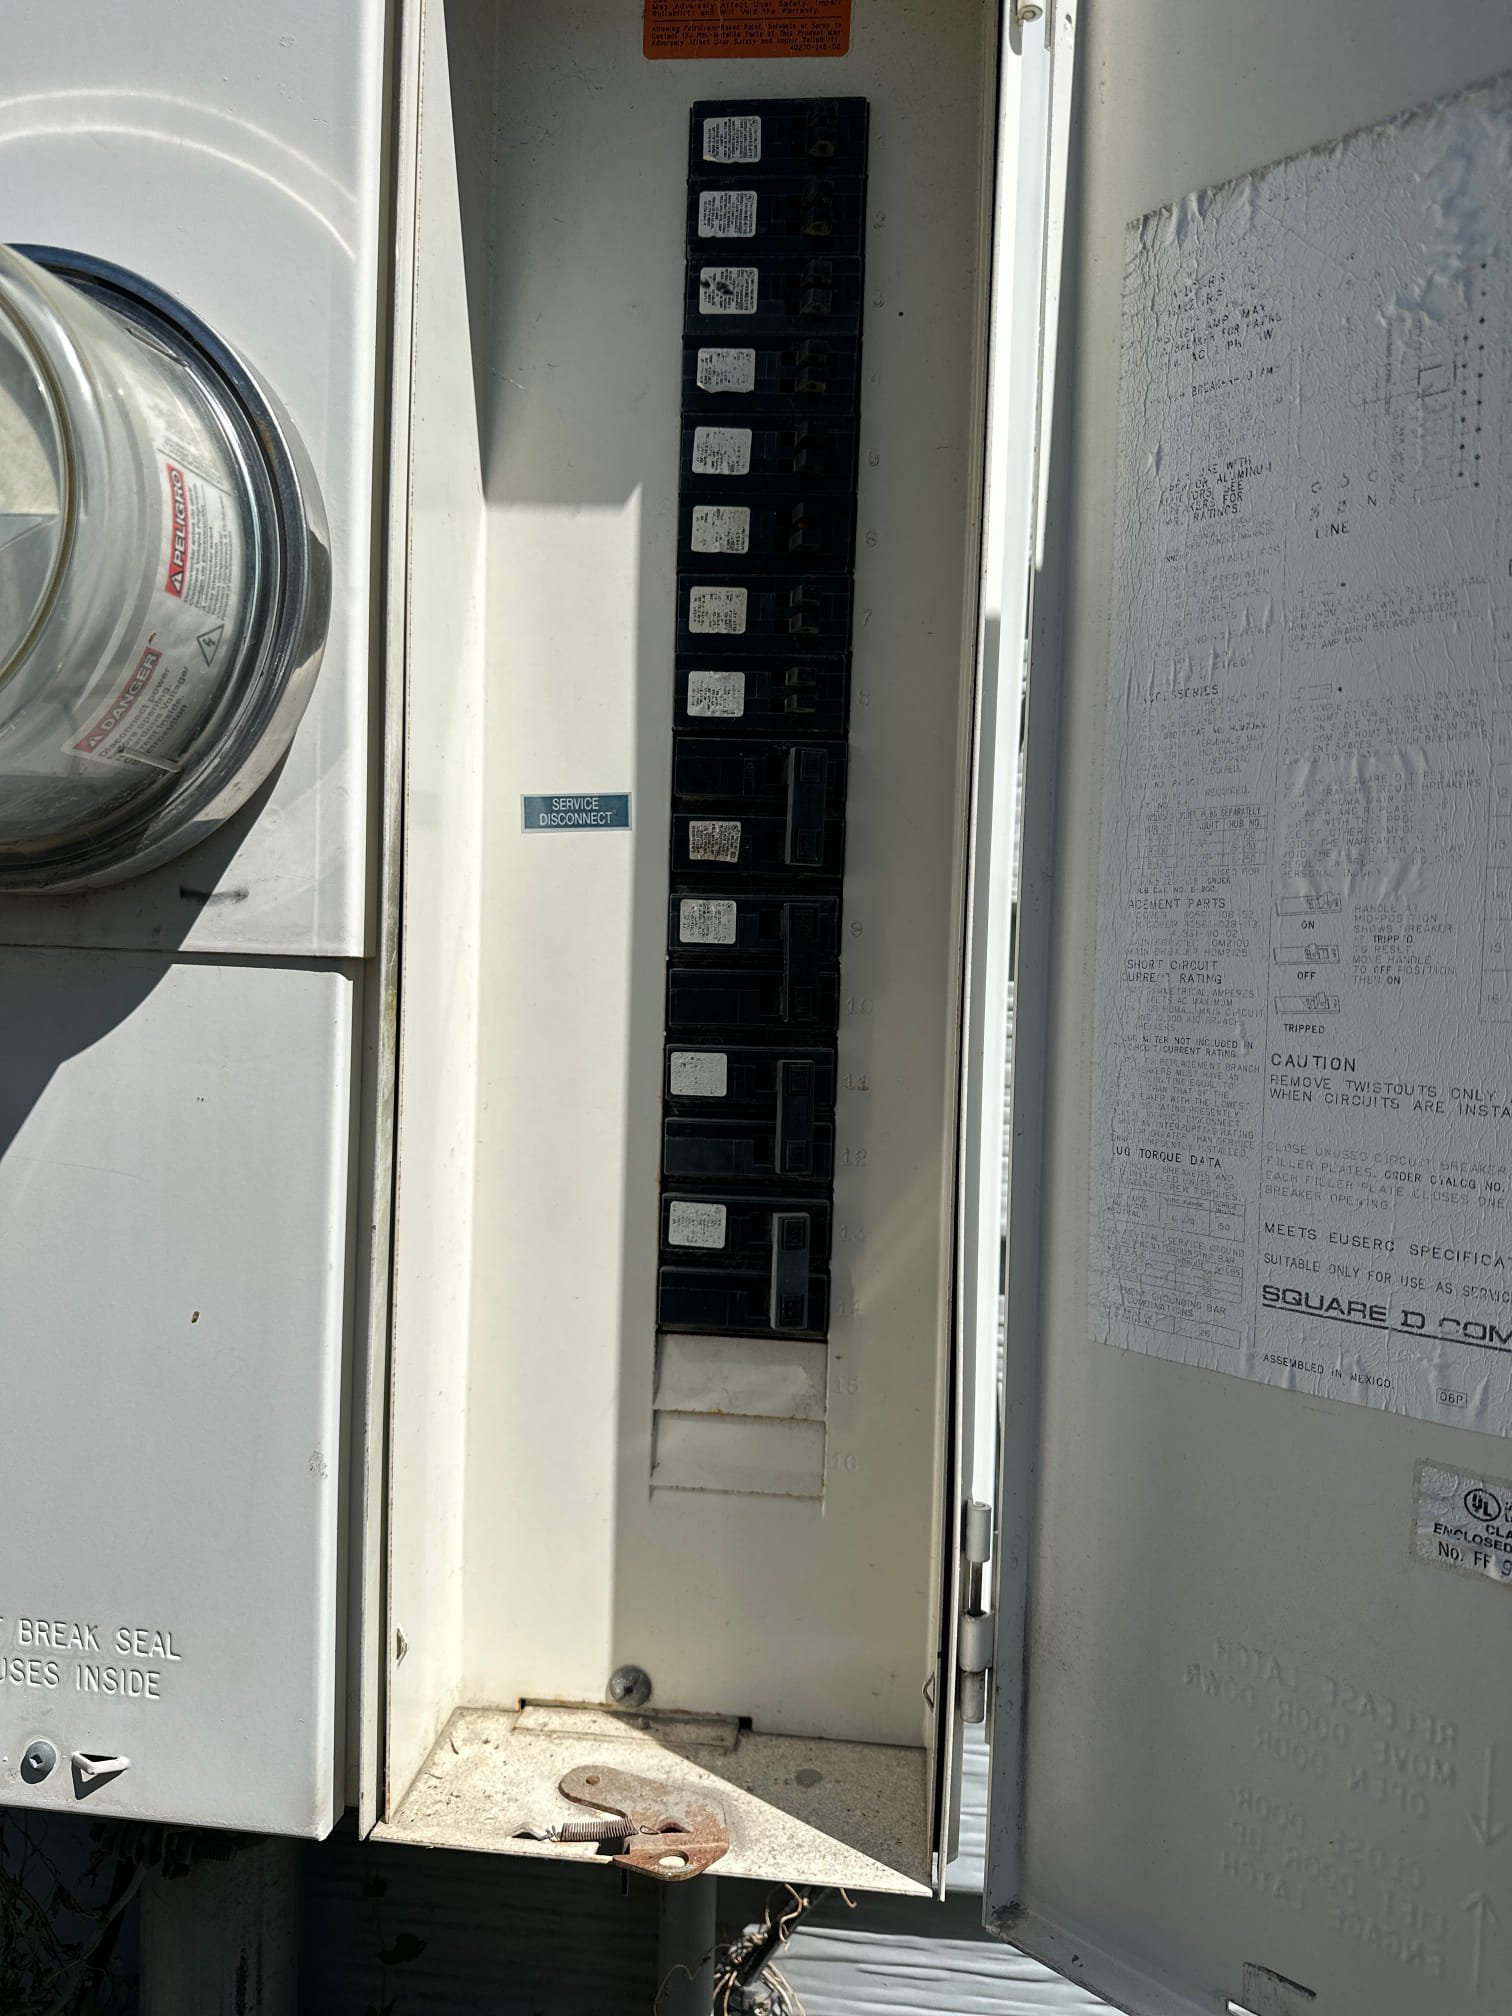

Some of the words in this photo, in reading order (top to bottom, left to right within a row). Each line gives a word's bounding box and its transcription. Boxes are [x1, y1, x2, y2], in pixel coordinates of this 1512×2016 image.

[171, 469, 189, 567] PELIGRO
[863, 608, 873, 627] 7
[100, 653, 158, 732] DANGER
[552, 797, 600, 811] SERVICE
[539, 812, 612, 826] DISCONNECT
[1229, 819, 1244, 828] HUB
[1188, 898, 1226, 910] PARTS
[1354, 903, 1397, 913] HANDLE
[1300, 920, 1316, 930] ON
[1354, 914, 1438, 924] MID-POSTION
[850, 920, 863, 938] 9
[1354, 924, 1393, 934] SHOWS
[1373, 934, 1412, 944] TRIPPD
[1353, 945, 1368, 954] TO
[1127, 959, 1163, 970] SHORT
[1170, 960, 1218, 972] CIRCUIT
[1352, 955, 1382, 964] MOVE
[1388, 954, 1432, 964] HANDLE
[1296, 971, 1318, 982] OFF
[1352, 966, 1368, 975] TO
[1374, 966, 1392, 975] OFF
[1180, 973, 1222, 984] RATING
[1386, 976, 1402, 985] ON
[847, 994, 874, 1016] 10
[1283, 1023, 1326, 1034] TRIPPED
[1195, 1038, 1238, 1049] INCUDED
[1162, 1046, 1200, 1056] CURRENT
[1225, 1063, 1260, 1073] BRANCH
[1270, 1052, 1356, 1072] CAUTION
[1270, 1074, 1332, 1090] REMOVE
[1344, 1079, 1438, 1098] TWISTOUTS
[1450, 1087, 1497, 1103] ONLY
[1269, 1088, 1312, 1103] WHEN
[1324, 1093, 1400, 1110] CIRCUITS
[1413, 1100, 1446, 1114] ARE
[1139, 1148, 1182, 1163] TORQUE
[1190, 1154, 1222, 1168] DATA
[1266, 1142, 1308, 1156] CLOSE
[1315, 1146, 1369, 1163] UNUSED
[1440, 1161, 1507, 1176] BREAKER
[1266, 1156, 1314, 1171] FILLER
[1320, 1162, 1378, 1179] PLATES.
[1384, 1169, 1422, 1184] ORDER
[1485, 1182, 1505, 1193] NO.
[1266, 1170, 1298, 1183] EACH
[1305, 1175, 1354, 1190] FILLER
[1413, 1189, 1470, 1206] CLOSES
[1478, 1196, 1505, 1210] ONE
[1266, 1186, 1322, 1202] BREAKER
[1218, 1222, 1230, 1231] 50
[1264, 1222, 1318, 1240] MEETS
[1329, 1232, 1396, 1252] EUSERC
[1264, 1252, 1320, 1272] SUITABLE
[1328, 1264, 1360, 1280] ONLY
[1368, 1270, 1392, 1285] FOR
[1400, 1275, 1426, 1291] USE
[1436, 1281, 1454, 1295] AS
[1207, 1304, 1227, 1315] BAR
[1262, 1284, 1388, 1324] SQUARE
[1400, 1310, 1426, 1330] D
[1263, 1352, 1325, 1375] ASSEMBLED
[1332, 1368, 1343, 1379] IN
[1350, 1373, 1396, 1390] MEXICO.
[1472, 1492, 1494, 1518] UL
[1432, 1522, 1512, 1553] ENCLOSED
[18, 1618, 101, 1652] BREAK
[115, 1626, 182, 1661] SEAL
[76, 1664, 162, 1700] INSIDE
